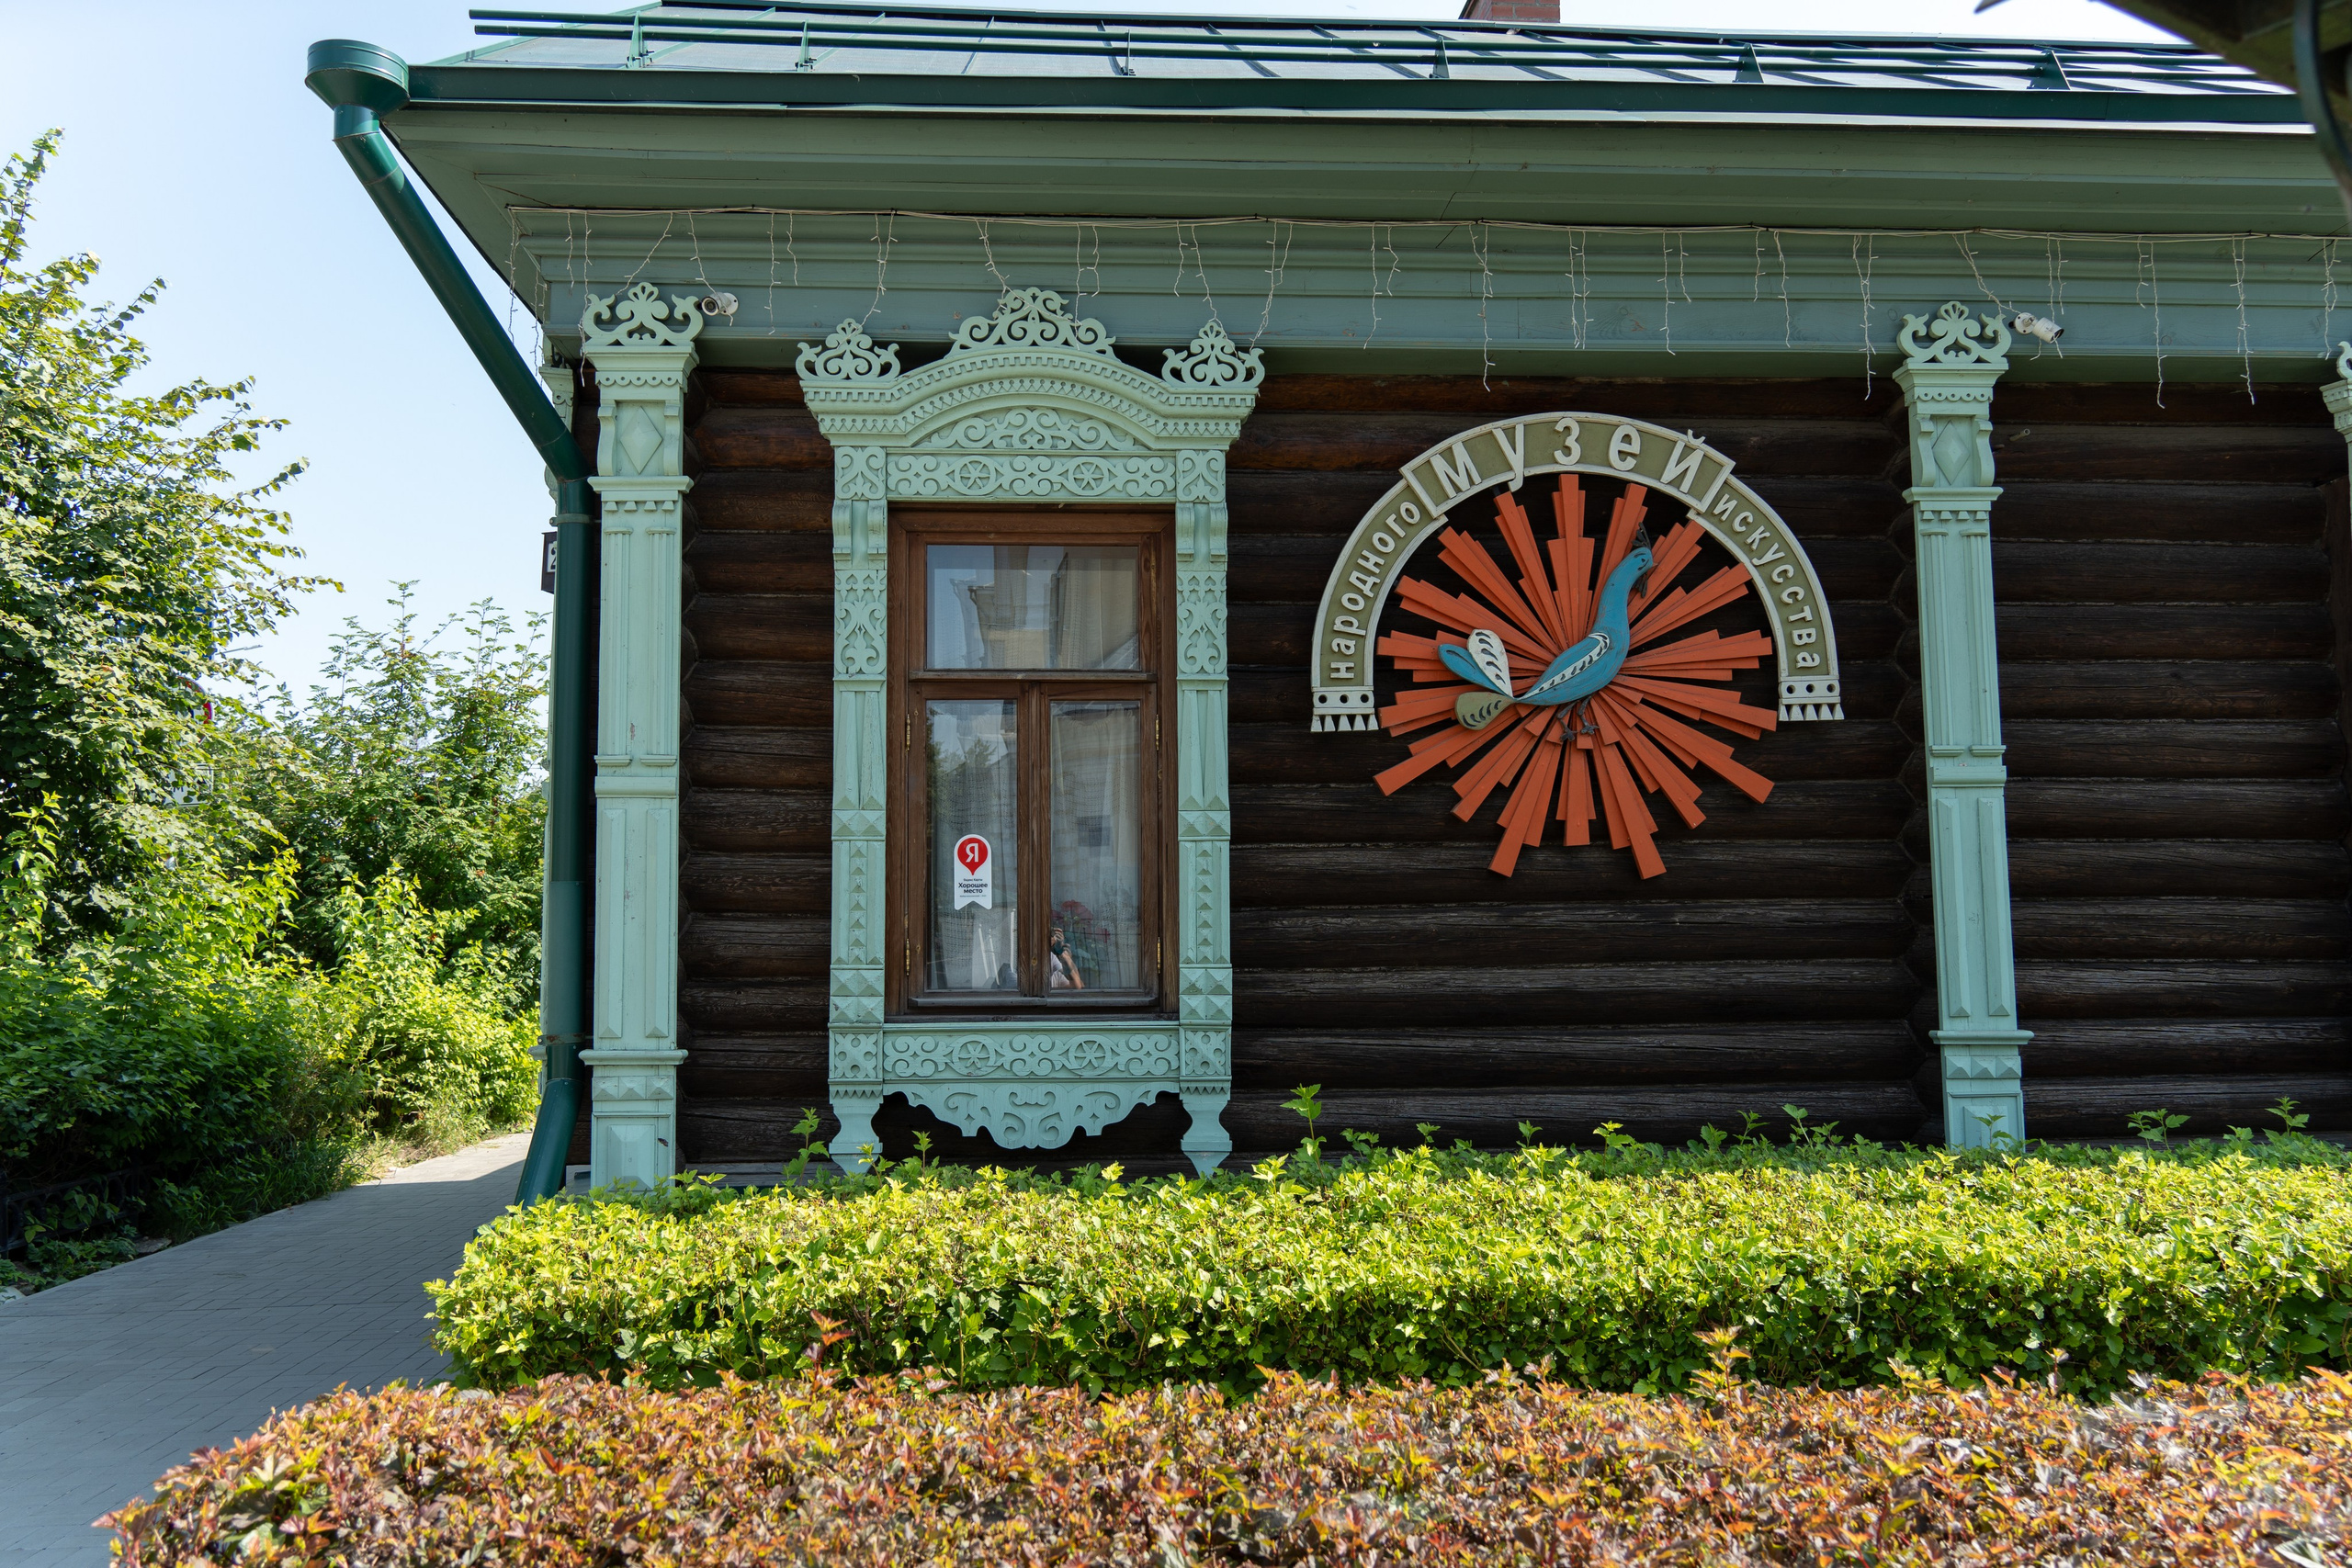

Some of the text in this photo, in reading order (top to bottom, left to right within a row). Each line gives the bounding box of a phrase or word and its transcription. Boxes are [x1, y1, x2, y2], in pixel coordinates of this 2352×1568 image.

[1329, 501, 1421, 680] народного
[1712, 493, 1821, 669] искусства
[965, 842, 979, 863] Я
